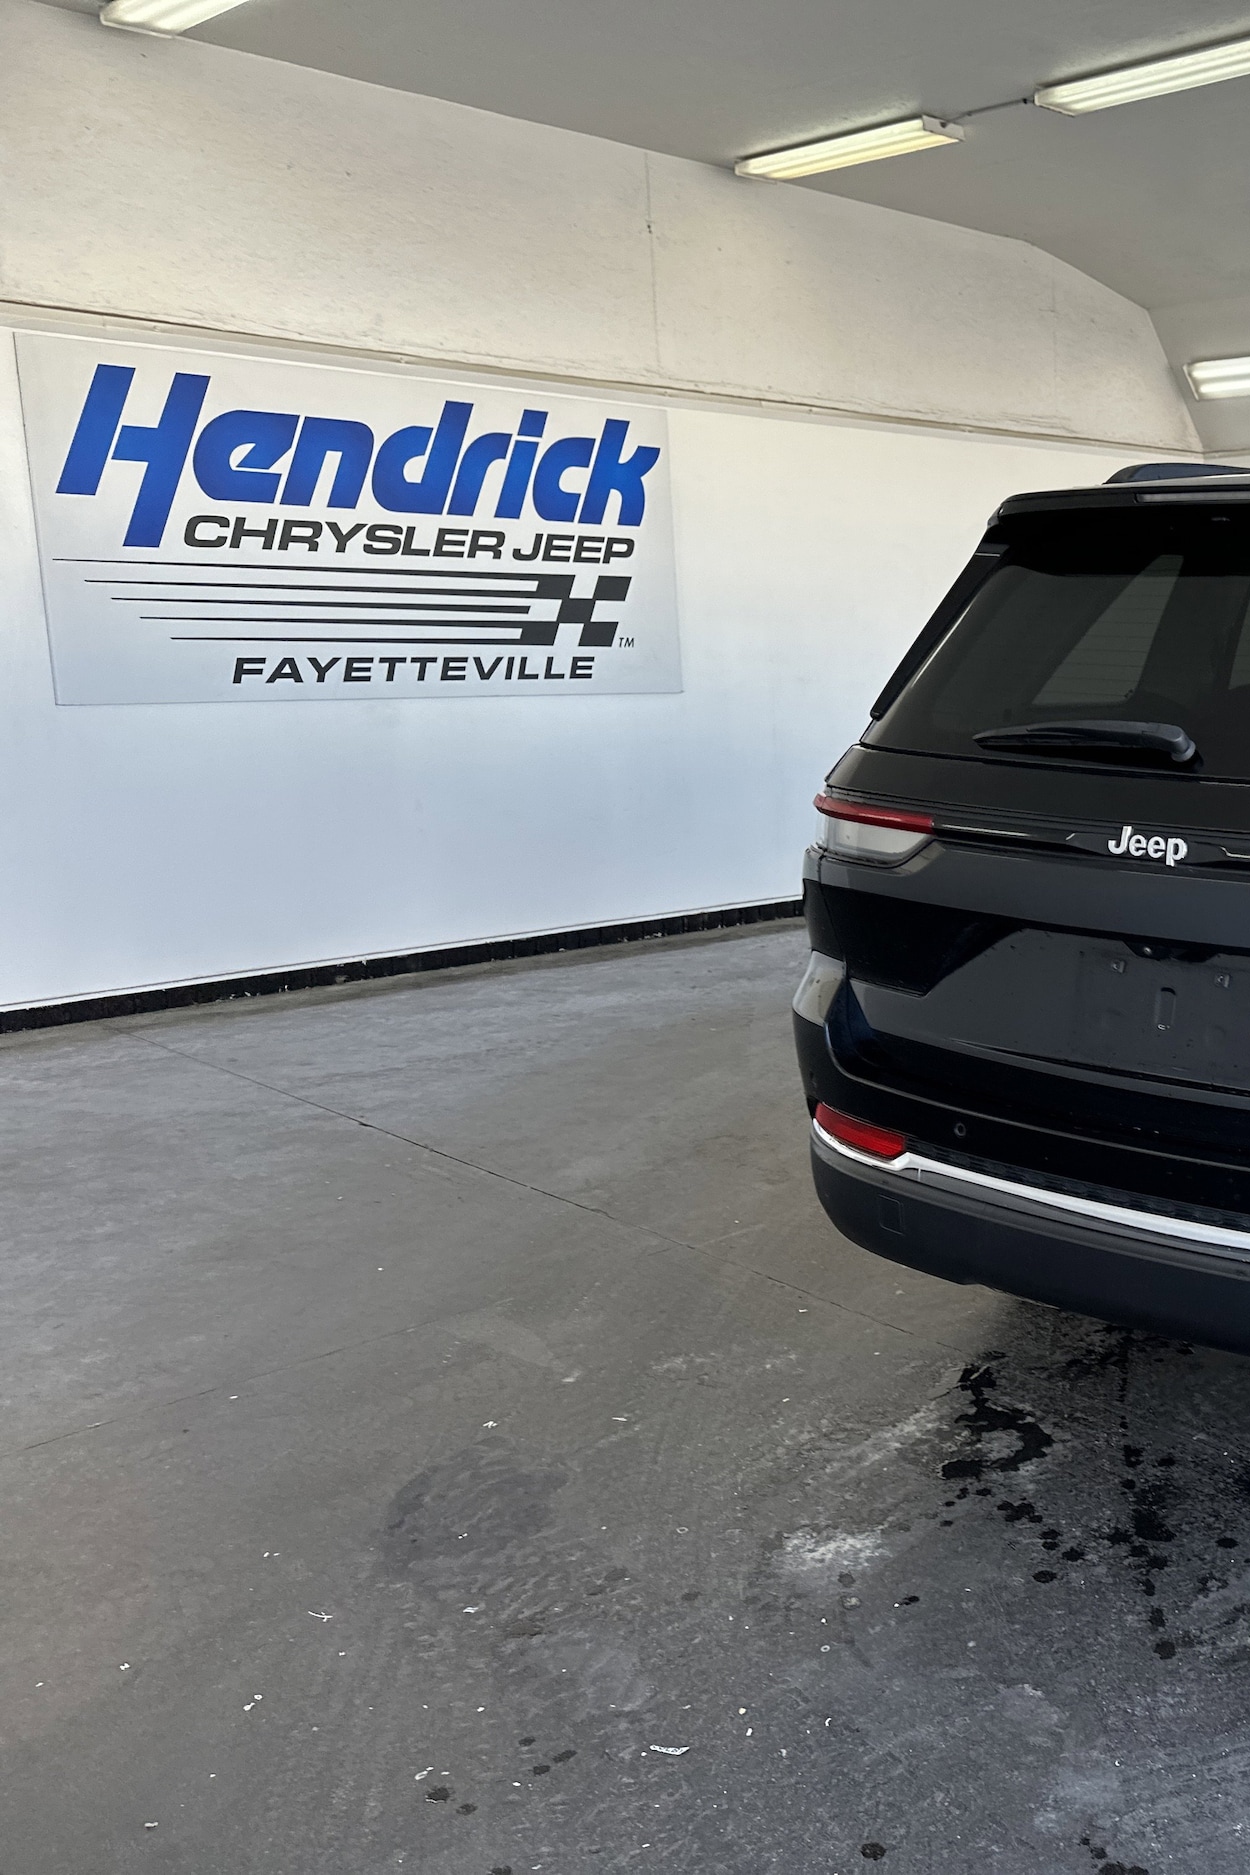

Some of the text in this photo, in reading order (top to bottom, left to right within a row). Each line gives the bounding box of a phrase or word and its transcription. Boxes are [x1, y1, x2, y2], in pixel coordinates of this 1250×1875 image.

[56, 364, 660, 548] Hendrick
[184, 515, 636, 565] CHRYSLER JEEP
[232, 656, 595, 684] FAYETTEVILLE
[1107, 825, 1188, 867] Jeep
